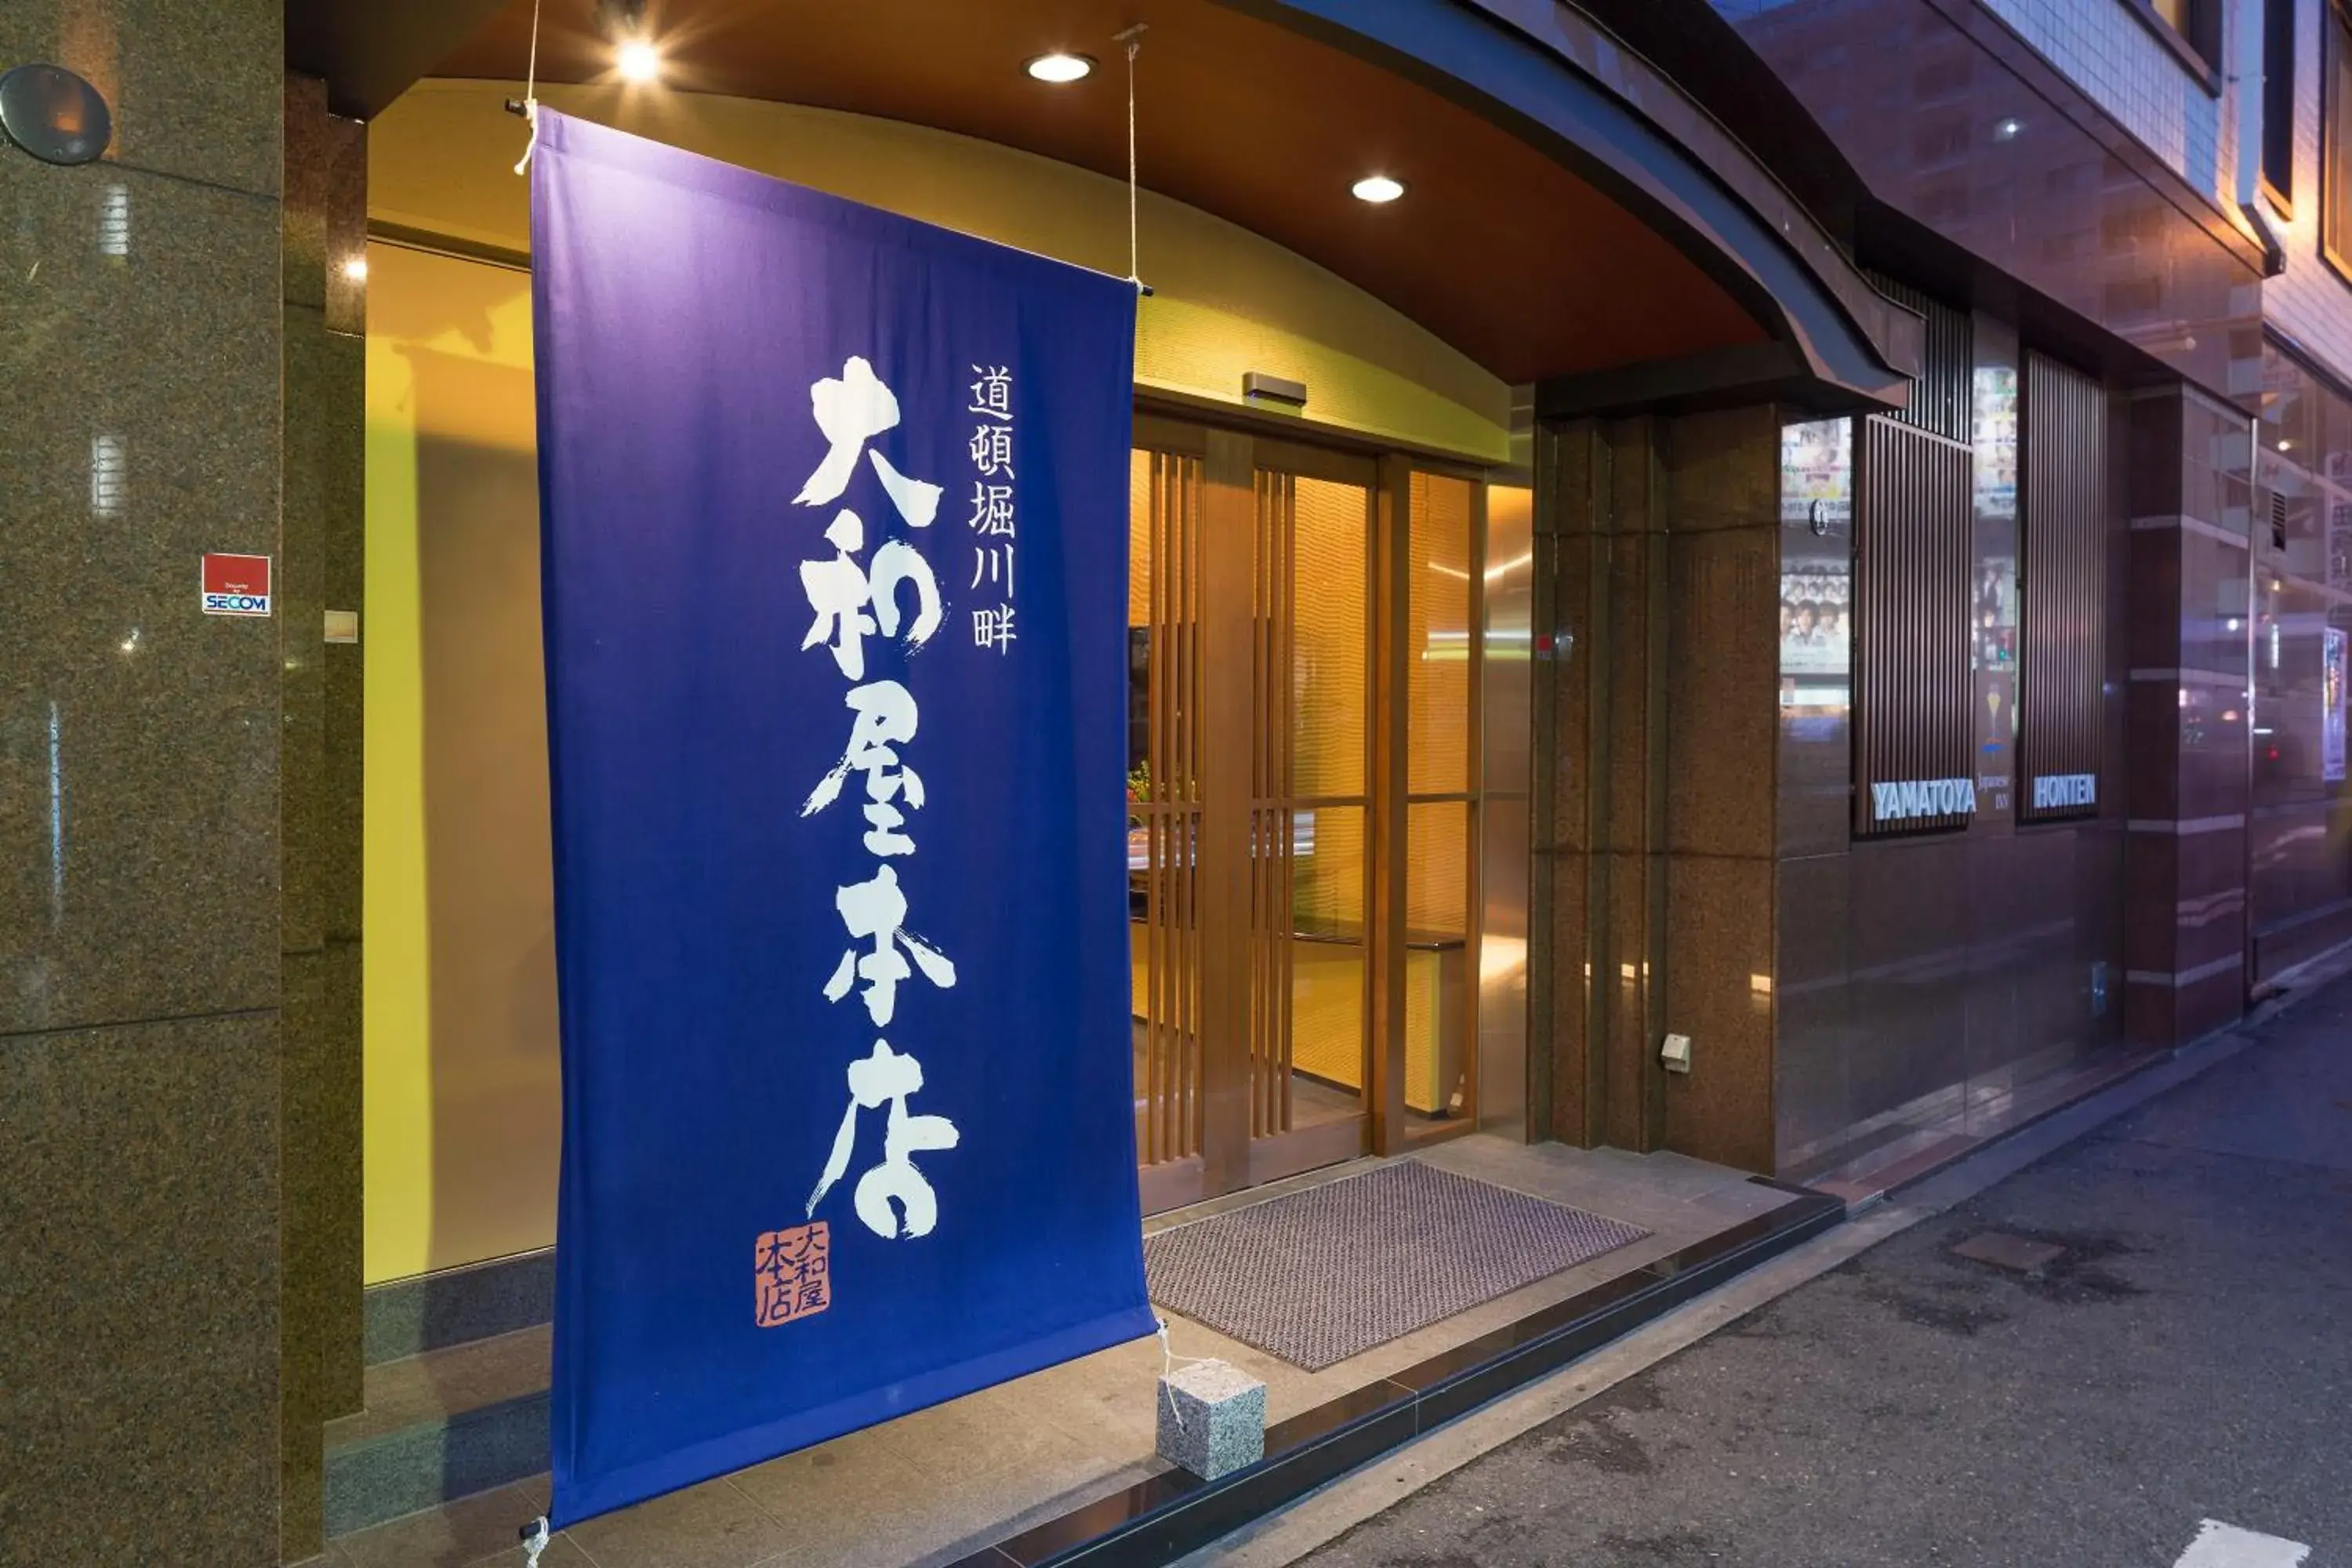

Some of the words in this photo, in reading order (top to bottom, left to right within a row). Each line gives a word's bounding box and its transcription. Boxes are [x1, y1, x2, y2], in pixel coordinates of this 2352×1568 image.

[967, 362, 1018, 657] 道頓堀川畔
[206, 595, 267, 611] SECOM
[791, 355, 960, 1240] 大和屋本店
[1871, 778, 1977, 820] YAMATOYA
[2034, 773, 2096, 808] HONTEN
